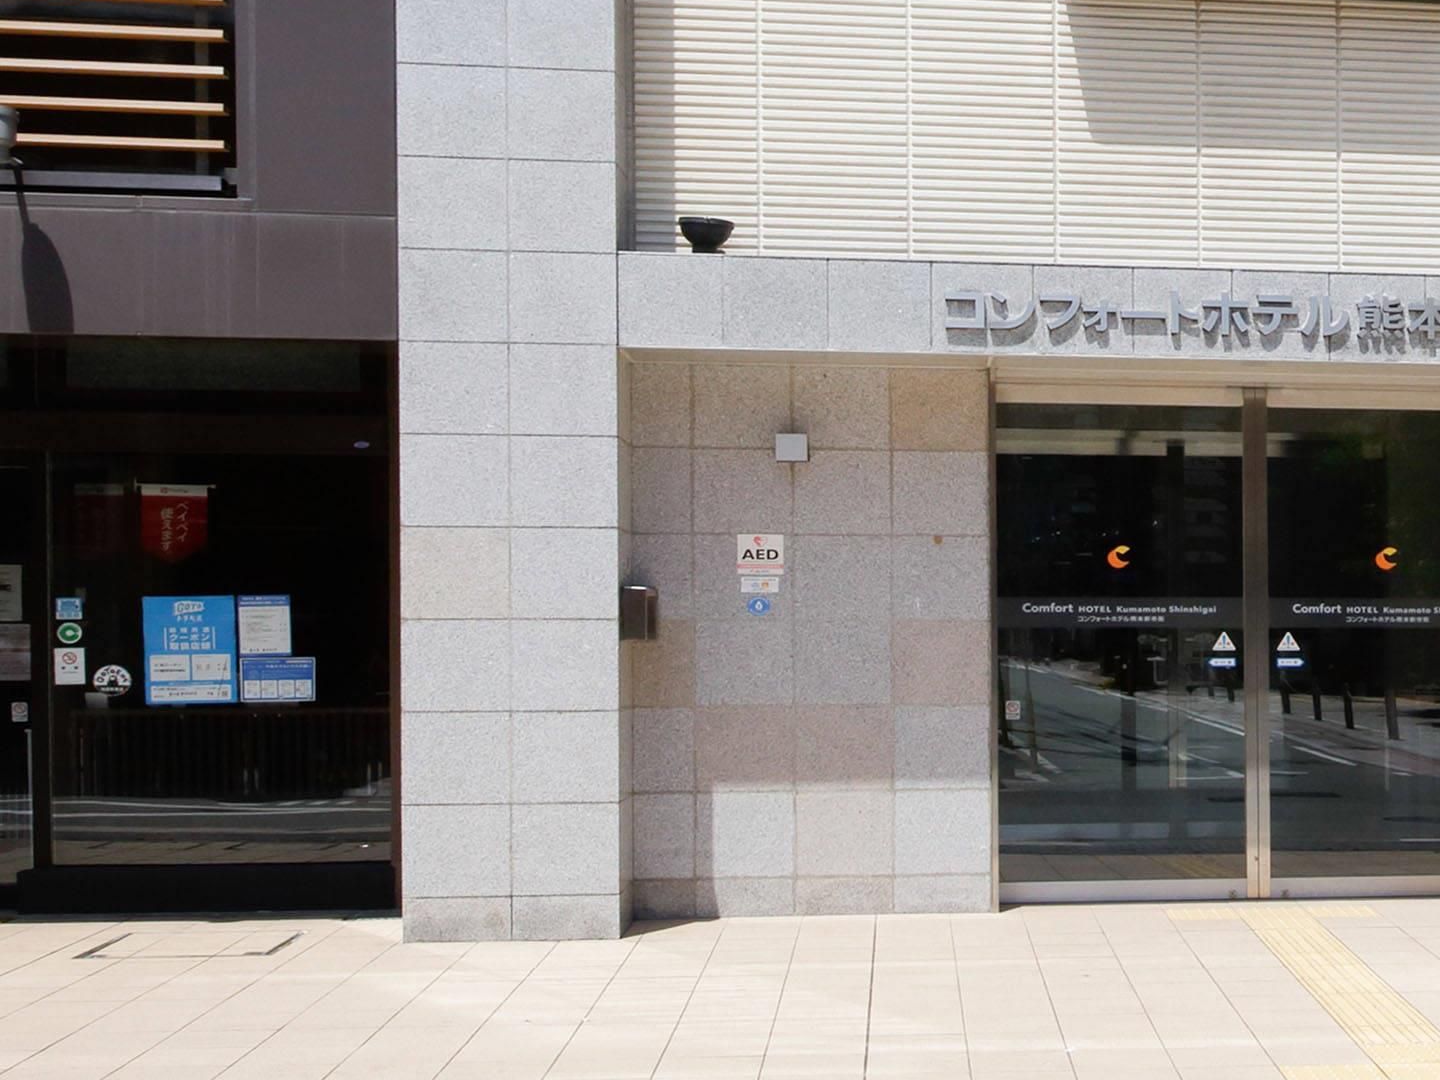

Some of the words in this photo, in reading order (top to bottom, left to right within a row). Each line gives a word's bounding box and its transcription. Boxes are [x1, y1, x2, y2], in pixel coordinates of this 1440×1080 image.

[742, 549, 779, 560] AED
[1022, 602, 1074, 614] Comfort
[1116, 605, 1167, 613] Kumamoto
[1169, 604, 1217, 616] Shinshigai
[1292, 603, 1342, 614] Comfort
[1383, 606, 1431, 614] Kumamoto
